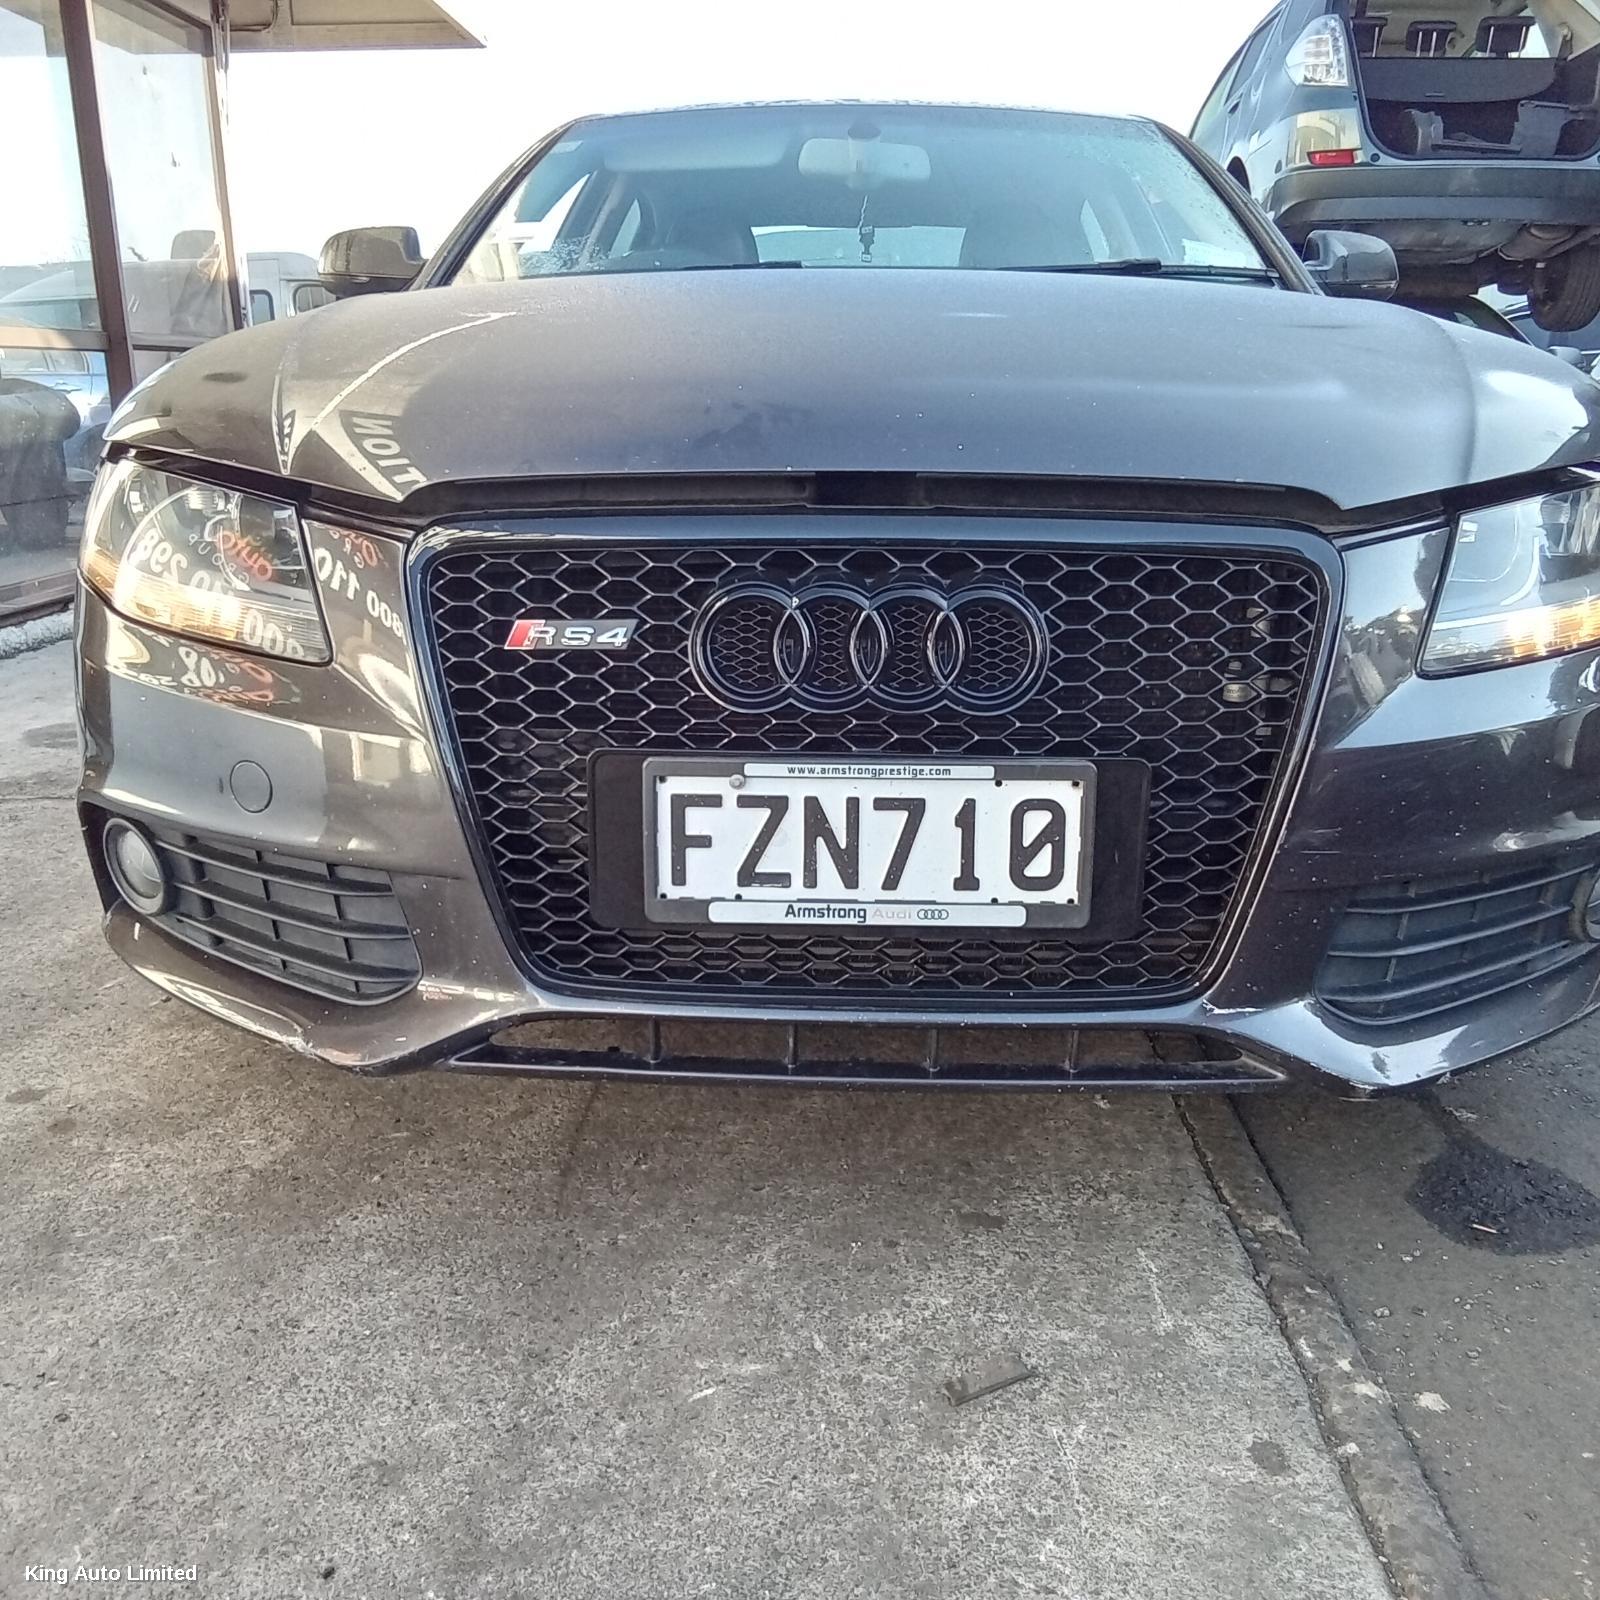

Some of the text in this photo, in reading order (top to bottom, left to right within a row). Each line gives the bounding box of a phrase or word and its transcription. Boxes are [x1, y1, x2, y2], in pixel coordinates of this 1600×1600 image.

[521, 625, 629, 647] RS4
[786, 765, 952, 778] www.armstrongprestige.com
[670, 794, 1067, 891] FZN710
[784, 904, 912, 924] Armstrong Audi
